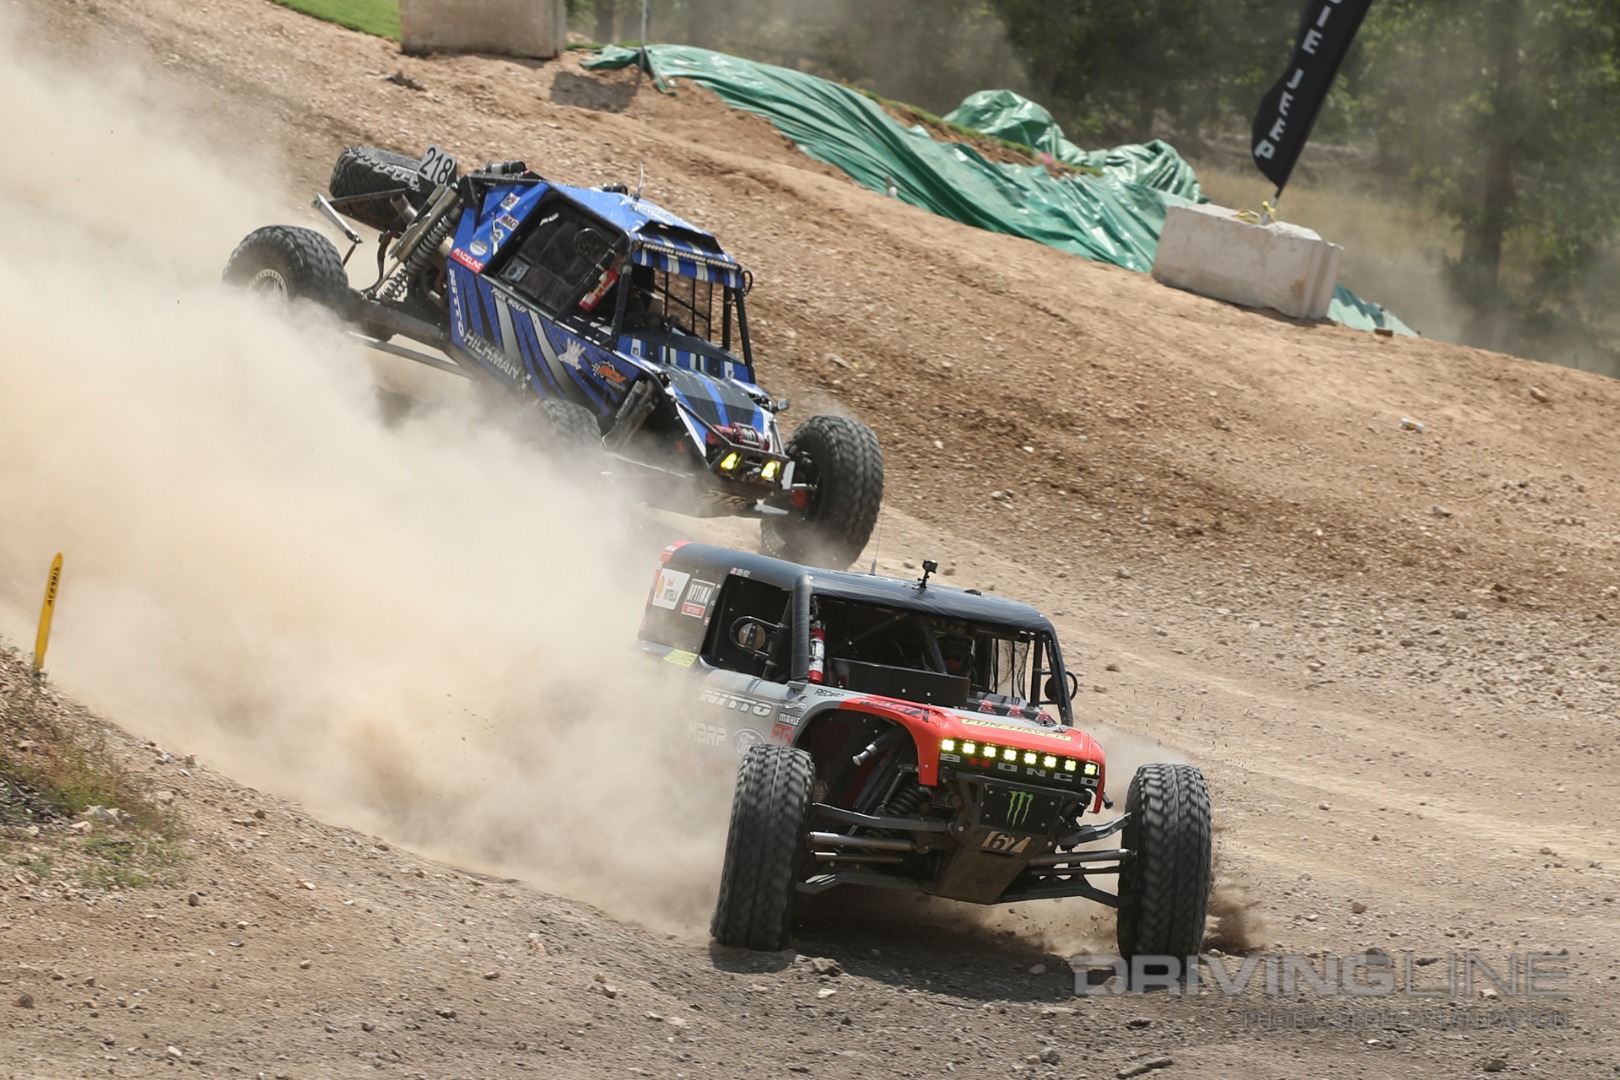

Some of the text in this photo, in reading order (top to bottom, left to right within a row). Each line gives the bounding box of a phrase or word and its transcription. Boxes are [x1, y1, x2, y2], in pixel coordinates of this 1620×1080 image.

[1301, 0, 1342, 54] IE
[419, 147, 453, 184] 218
[452, 247, 484, 270] RACELINE
[449, 268, 465, 337] NITTO
[491, 287, 506, 301] PAUL
[463, 329, 520, 380] HICKMAN
[699, 689, 773, 717] NITTO
[779, 713, 800, 726] MAHLE
[688, 720, 727, 748] MBRP
